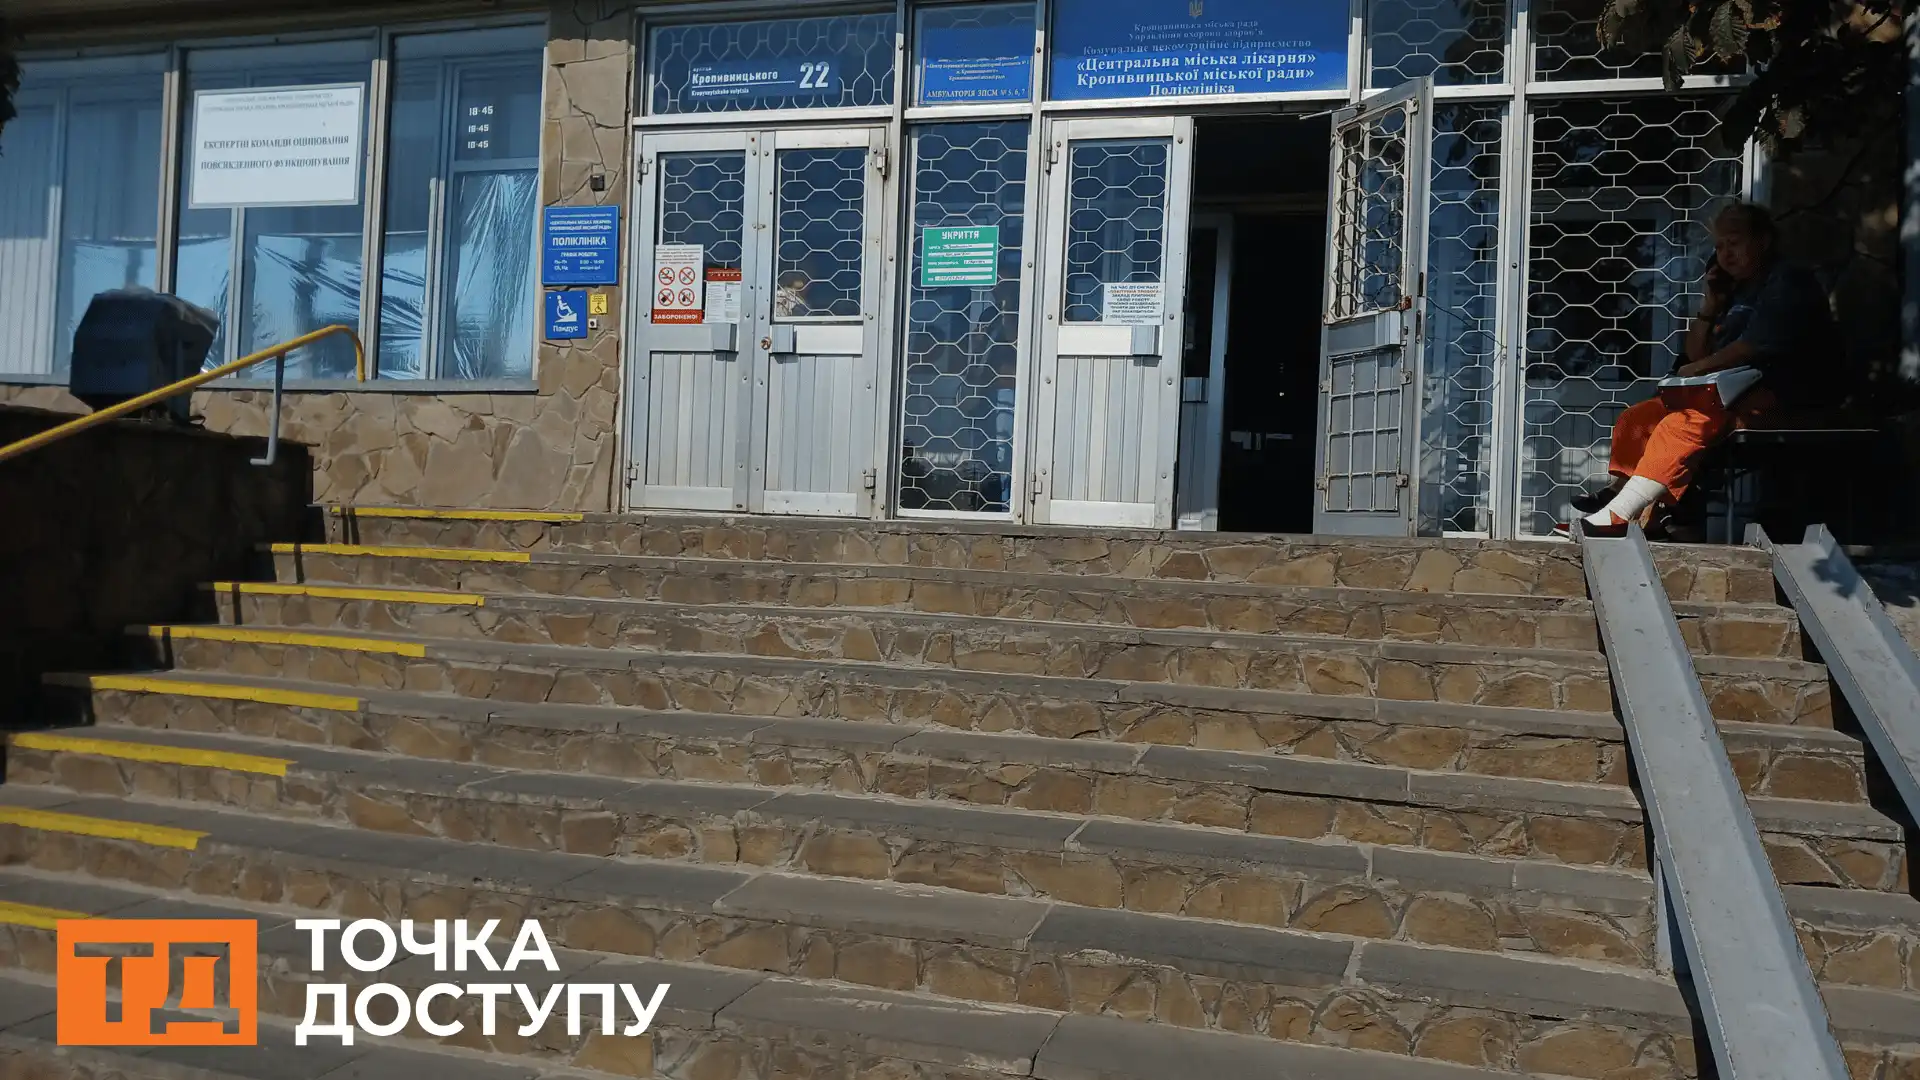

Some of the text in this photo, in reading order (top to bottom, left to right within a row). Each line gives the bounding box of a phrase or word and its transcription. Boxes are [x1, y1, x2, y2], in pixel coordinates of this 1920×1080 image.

[1135, 23, 1201, 32] Кропивницька
[1129, 31, 1180, 41] Управління
[1184, 30, 1220, 39] охорони
[1083, 46, 1148, 56] Комунальне
[1233, 40, 1311, 51] підприємство
[1077, 52, 1316, 72] «Центральна міська лікарня»
[692, 71, 778, 85] Кропивницького
[800, 61, 830, 89] 22
[1077, 68, 1314, 88] Кропивницької міської ради»
[927, 90, 975, 98] АМБУЛАТОРІЯ
[1149, 82, 1234, 96] Поліклініка
[204, 139, 249, 149] ЕКСПЕРТНІ
[250, 138, 292, 148] КОМАНДИ
[201, 157, 350, 170] ПОВСЯКДЕННОГО ФУНКЦІОНУВАННЯ
[552, 236, 607, 246] ПОЛІКЛІНІКА
[942, 231, 979, 240] УКРИТТЯ
[553, 325, 578, 333] Пандус
